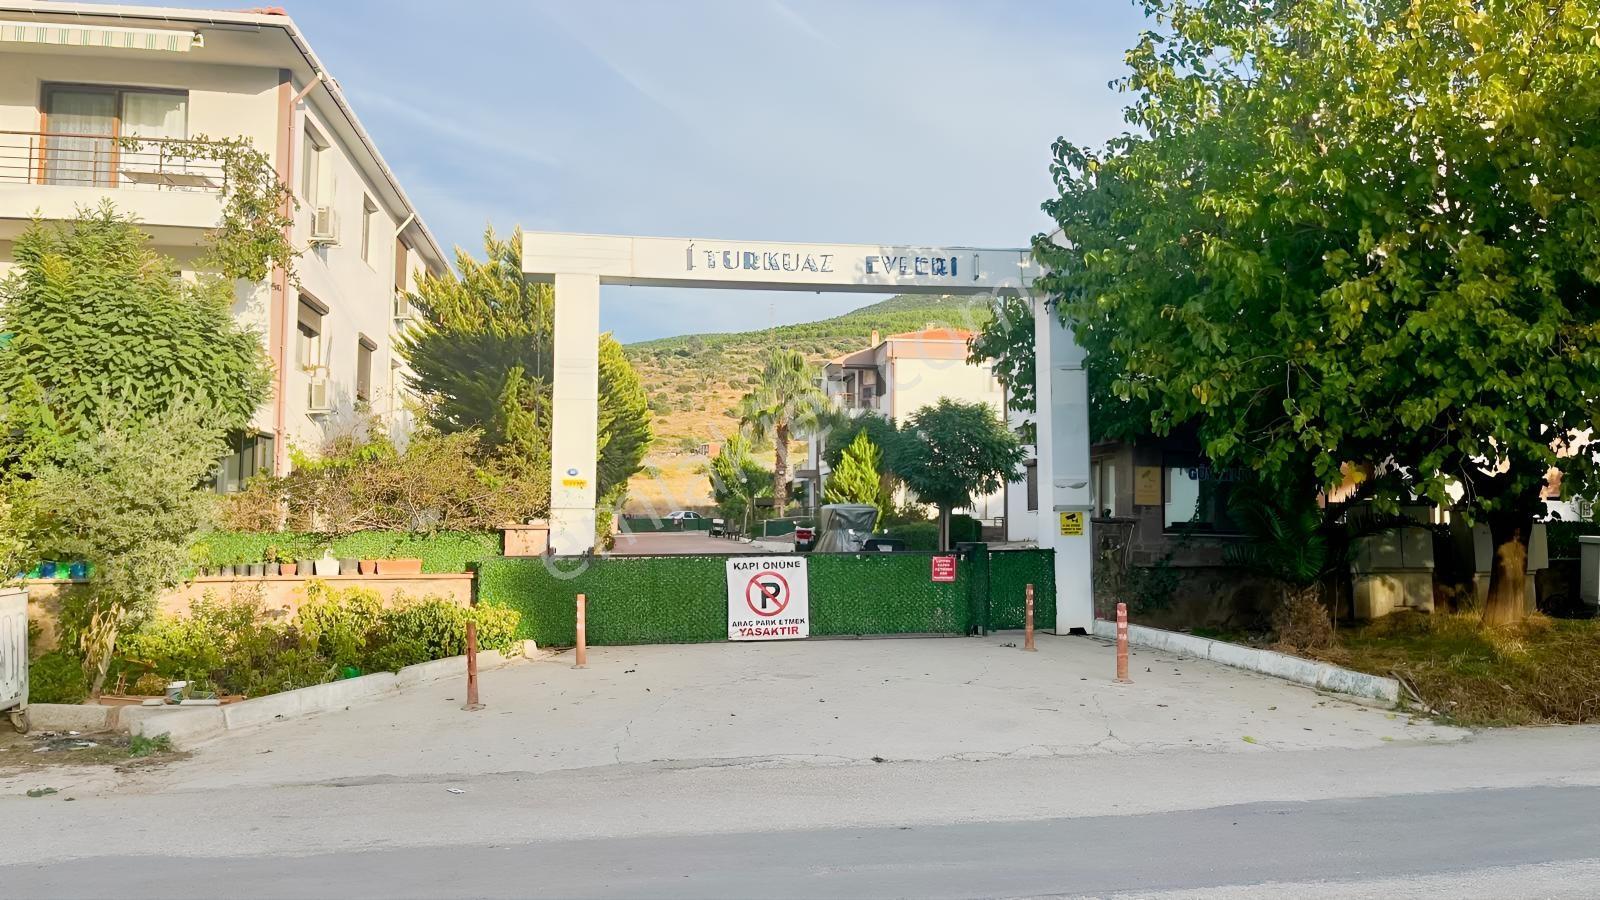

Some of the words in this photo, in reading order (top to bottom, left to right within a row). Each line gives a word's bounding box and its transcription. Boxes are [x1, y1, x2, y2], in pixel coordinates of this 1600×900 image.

[704, 250, 834, 273] TURKUAZ
[733, 562, 759, 570] KAPI
[739, 626, 799, 636] YASAKTIR
